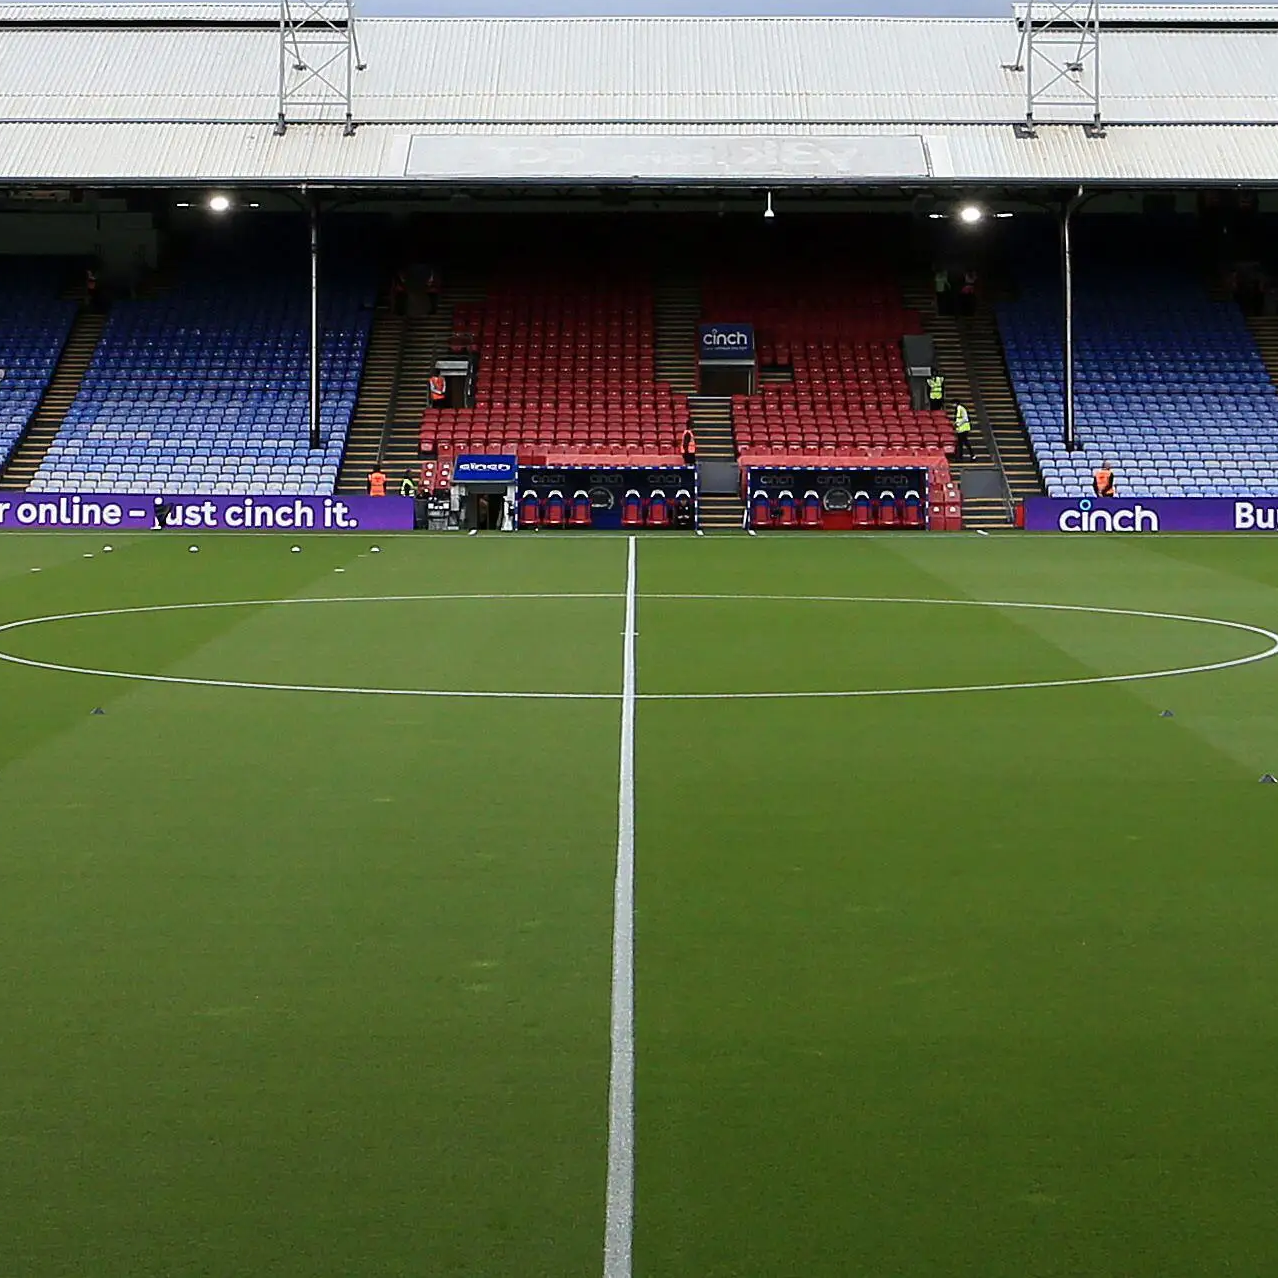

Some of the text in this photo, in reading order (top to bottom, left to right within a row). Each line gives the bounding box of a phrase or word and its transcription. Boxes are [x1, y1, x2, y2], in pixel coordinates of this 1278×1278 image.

[703, 328, 748, 345] cinch
[17, 495, 123, 524] online
[225, 498, 314, 526] cinch
[325, 498, 358, 526] it.
[1059, 498, 1159, 531] cinch
